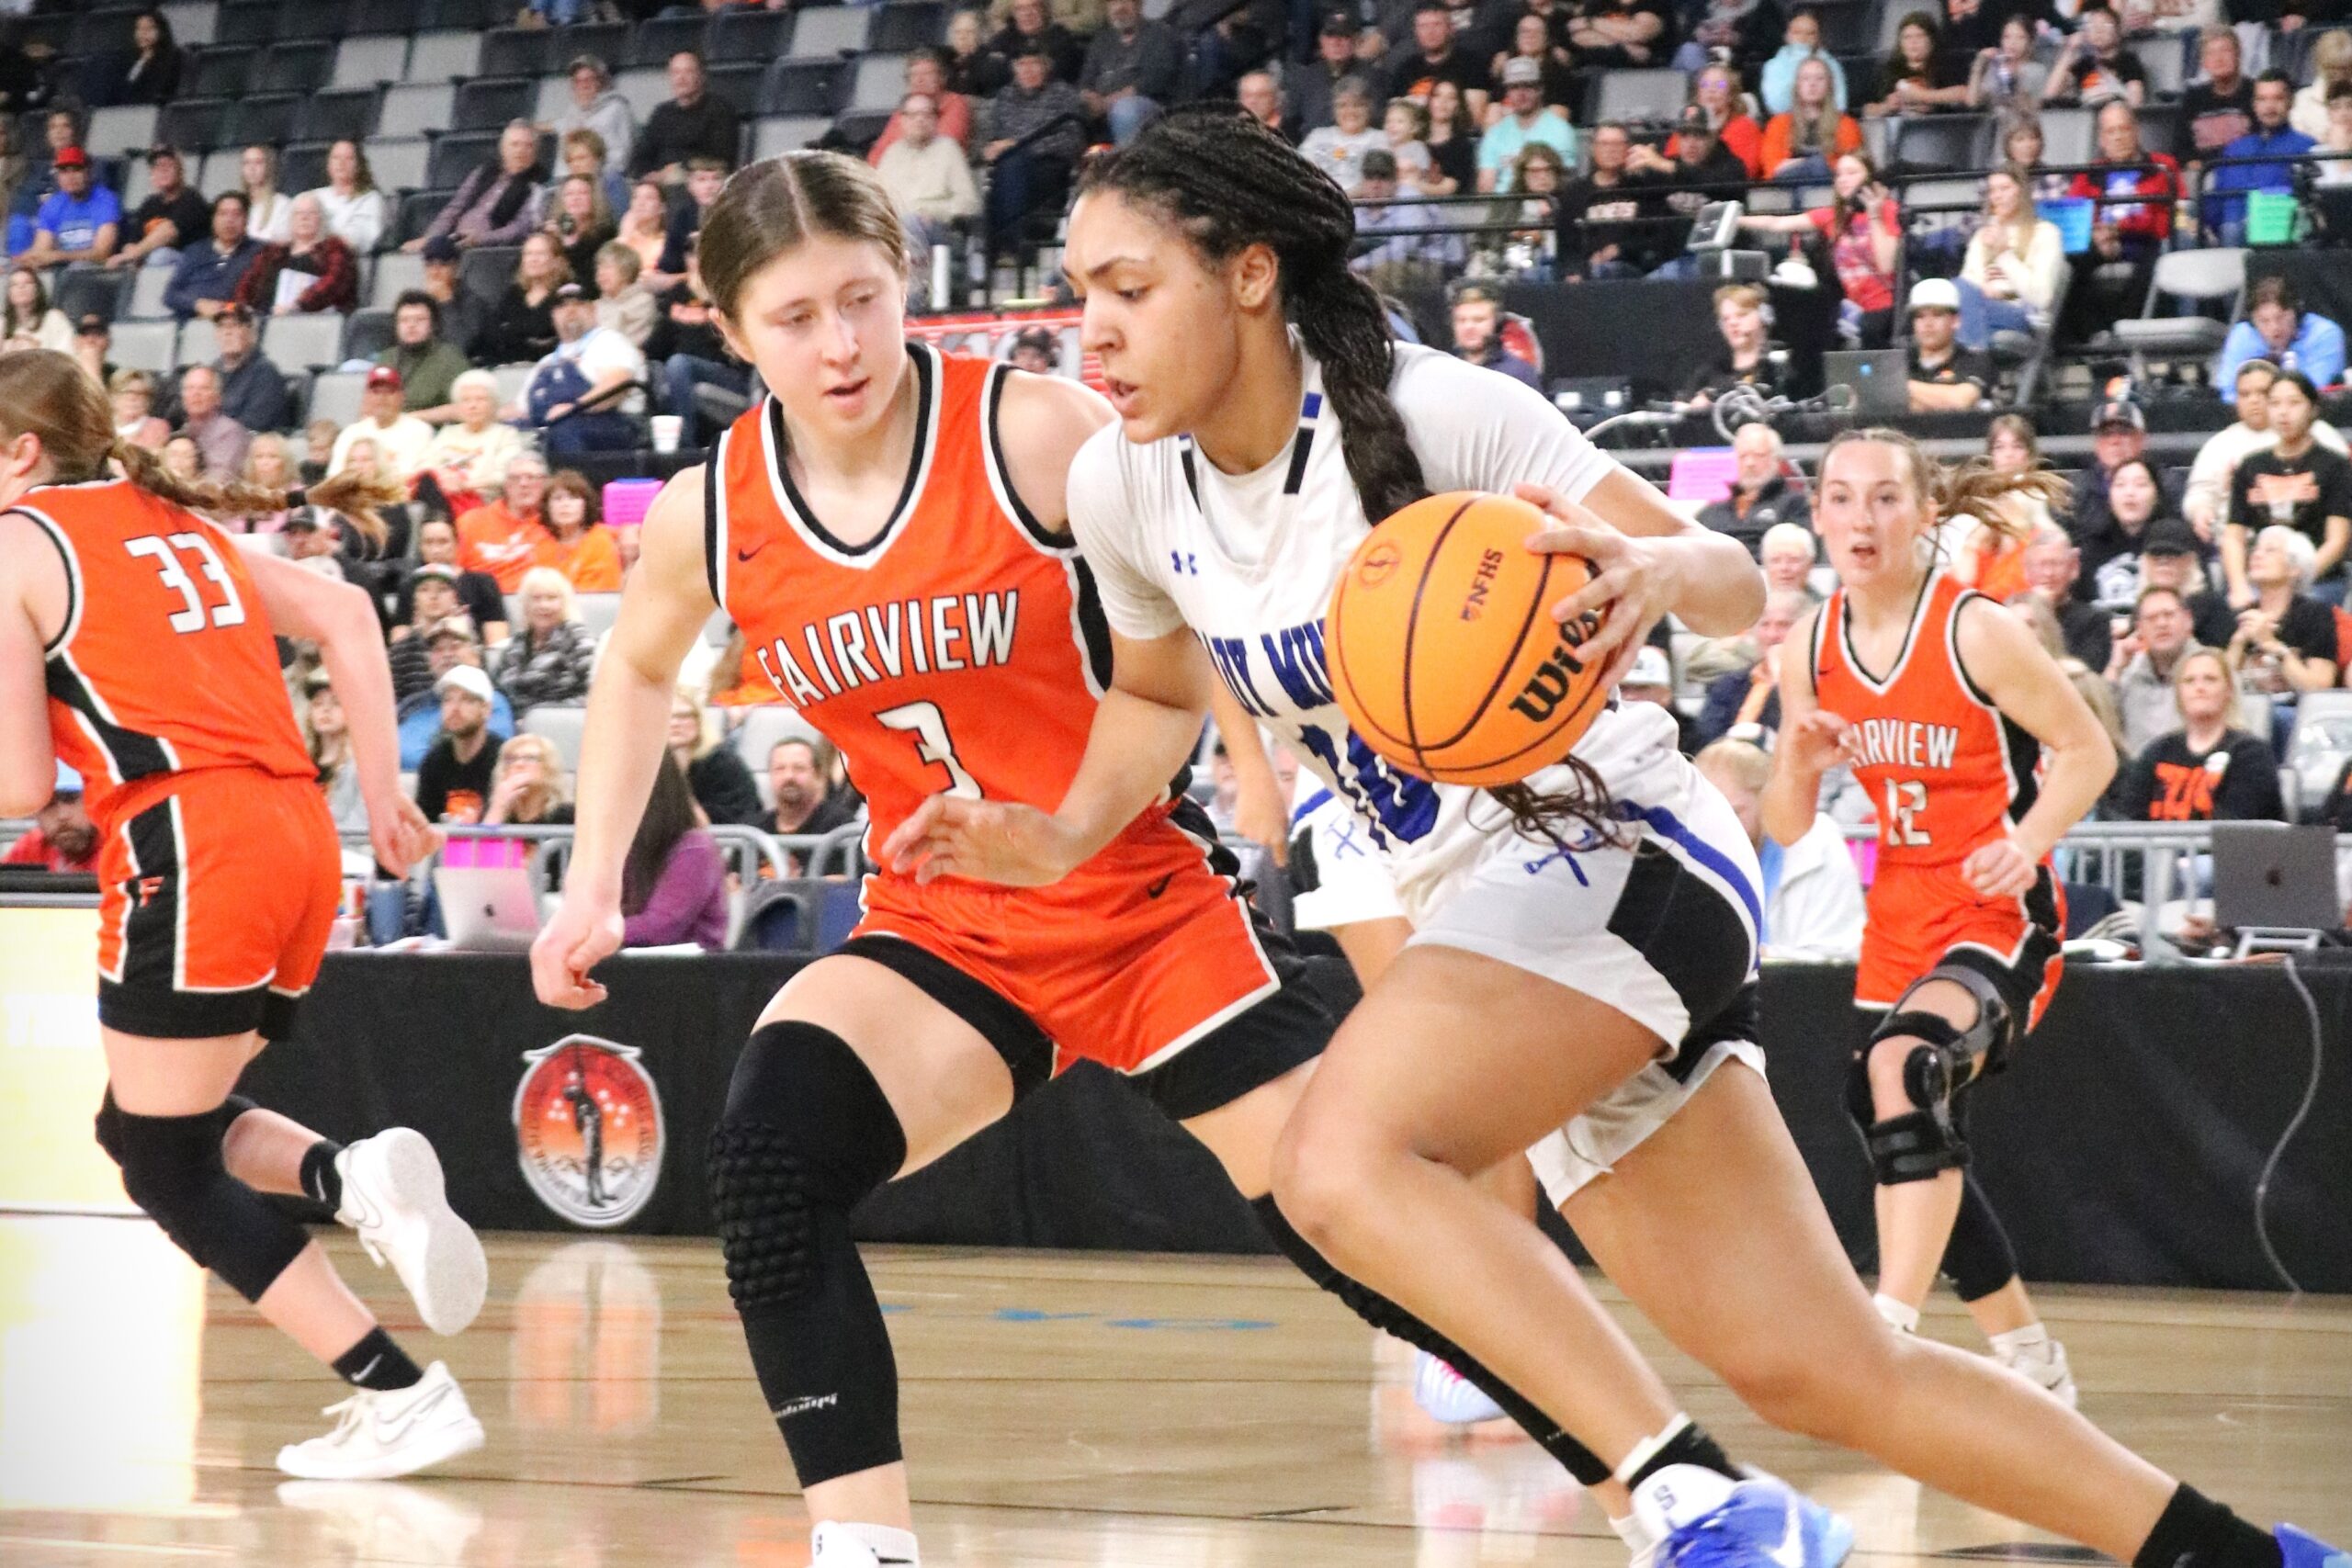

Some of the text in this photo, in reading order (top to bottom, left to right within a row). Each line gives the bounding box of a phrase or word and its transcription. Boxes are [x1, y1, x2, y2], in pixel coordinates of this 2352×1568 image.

[123, 531, 246, 634] 33
[1469, 547, 1505, 607] NFHS
[756, 588, 1019, 711] FAIRVIEW
[872, 699, 986, 800] 3
[1849, 717, 1959, 769] IRVIEW
[1884, 777, 1931, 847] 12
[139, 876, 165, 908] F
